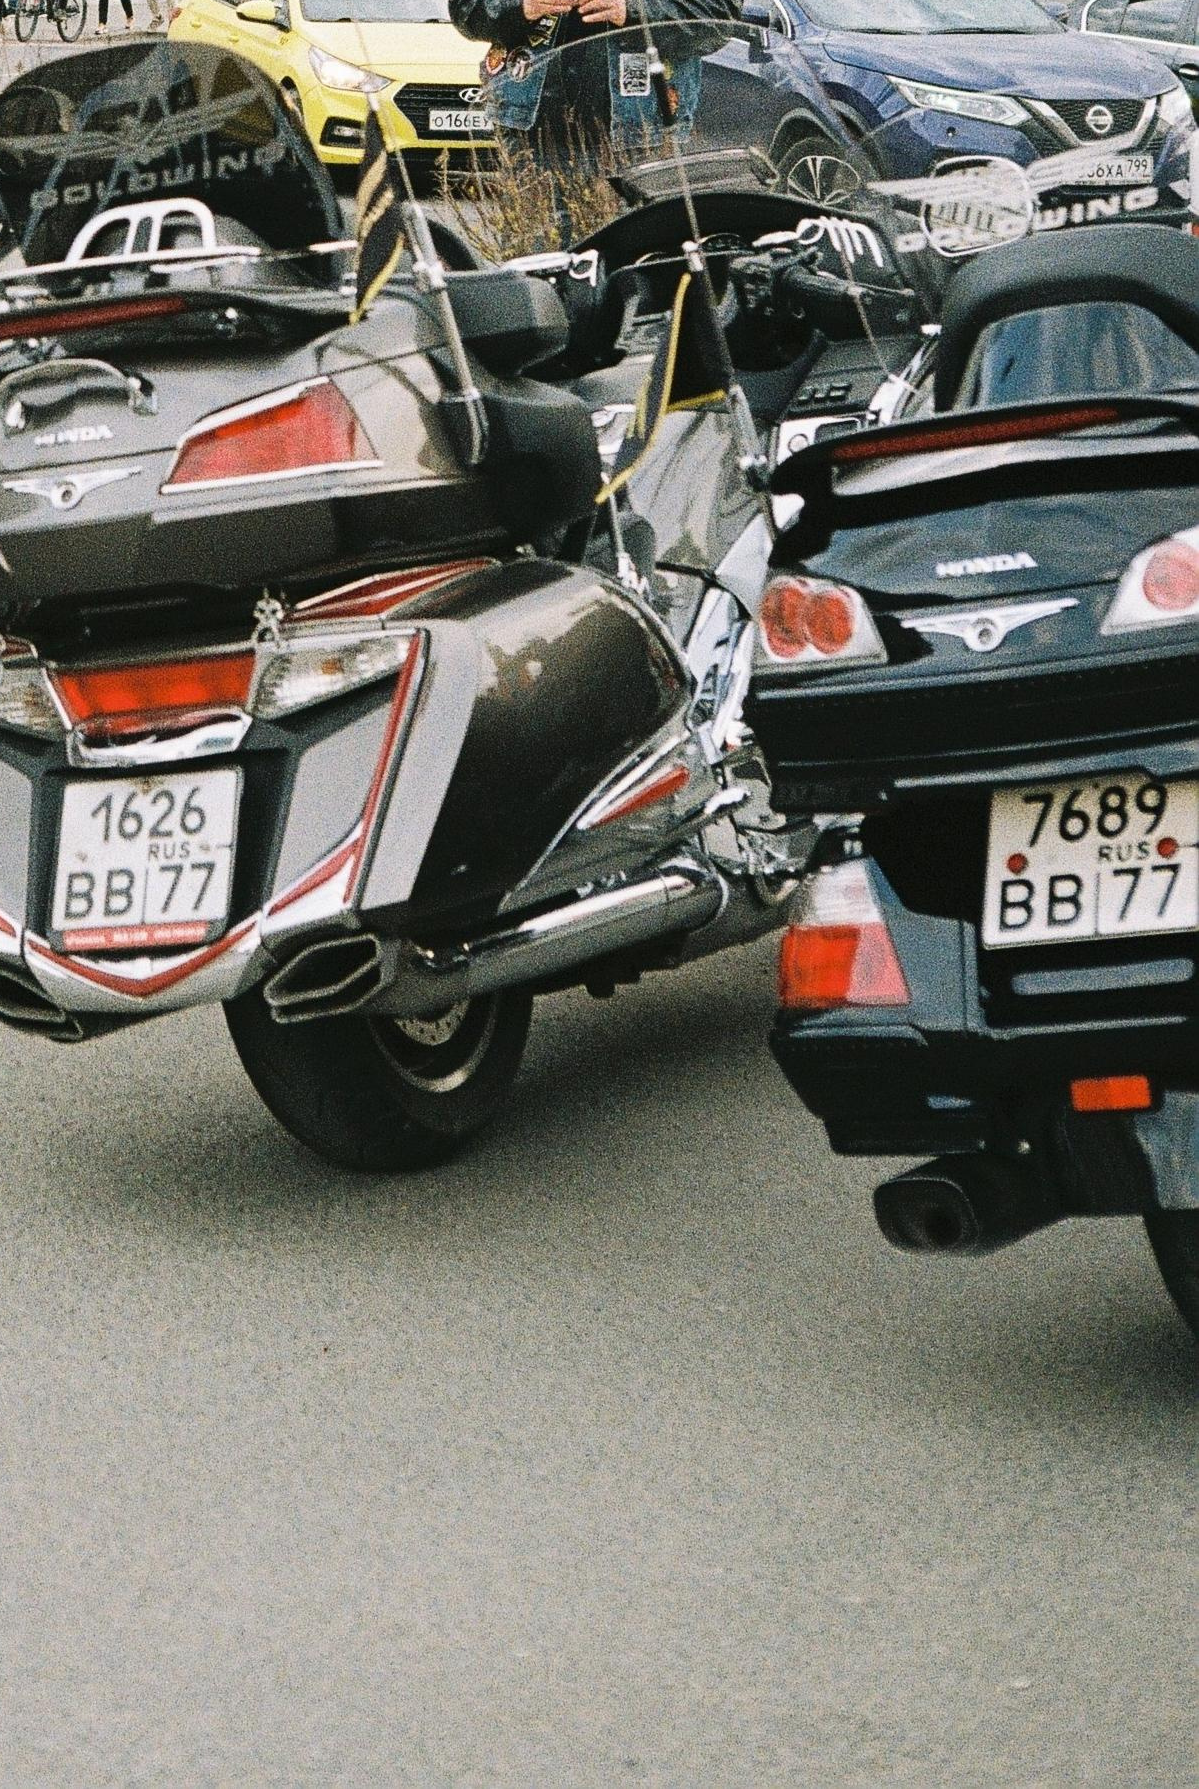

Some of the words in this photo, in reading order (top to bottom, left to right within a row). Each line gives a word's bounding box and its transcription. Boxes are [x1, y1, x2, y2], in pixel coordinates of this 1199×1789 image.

[1127, 159, 1148, 172] 799
[34, 425, 114, 445] HONDA
[935, 551, 1038, 578] HONDA
[91, 787, 206, 842] 1626
[1022, 782, 1168, 847] 7689
[149, 842, 191, 860] RUS
[1098, 840, 1150, 861] RUS
[159, 861, 216, 913] 77
[1113, 863, 1182, 923] 77
